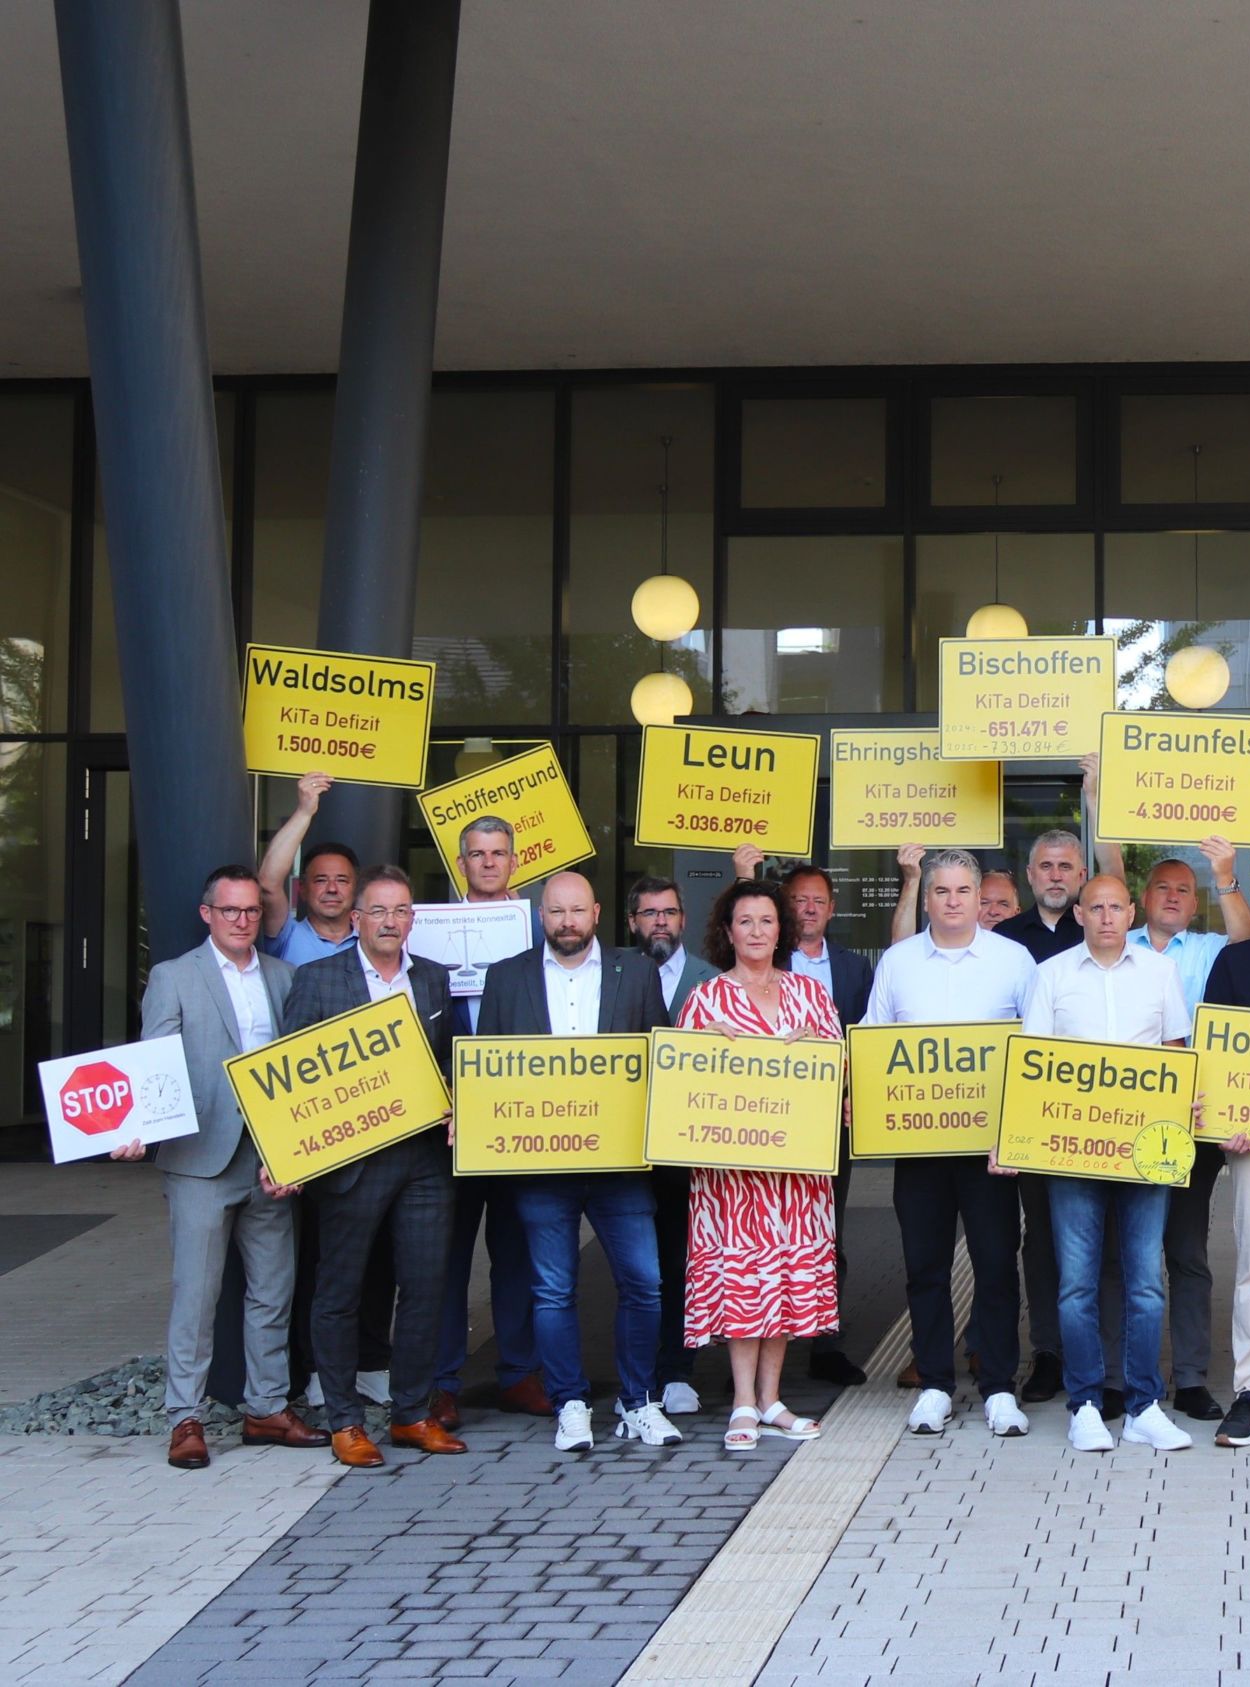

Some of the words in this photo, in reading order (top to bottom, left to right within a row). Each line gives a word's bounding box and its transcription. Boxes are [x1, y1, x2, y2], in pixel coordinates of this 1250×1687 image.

[959, 650, 1100, 676] Bischoffen
[252, 658, 425, 701] Waldsolms
[975, 694, 1012, 709] KiTa
[1019, 693, 1070, 708] Defizit
[280, 707, 319, 726] KiTa
[325, 711, 380, 732] Defizit
[980, 721, 1047, 737] -651.471
[1053, 720, 1068, 736] €
[277, 734, 377, 759] 1.500.050€
[683, 733, 775, 772] Leun
[836, 742, 939, 765] Ehringsha
[432, 760, 559, 826] Schöffengrund
[865, 784, 900, 799] KiTa
[907, 783, 957, 798] Defizit
[1136, 771, 1174, 789] KiTa
[1181, 773, 1235, 792] Defizit
[677, 784, 714, 801] KiTa
[720, 787, 771, 805] Defizit
[513, 810, 545, 833] efizit
[667, 814, 769, 835] -3.036.870€
[858, 812, 957, 828] -3.597.500€
[1128, 802, 1237, 823] -4.300.000€
[249, 1019, 403, 1101] Wetzlar
[460, 1048, 642, 1083] Hüttenberg
[656, 1043, 836, 1082] Greifenstein
[886, 1037, 996, 1075] Aßlar
[1021, 1049, 1178, 1094] Siegbach
[63, 1080, 129, 1117] STOP
[290, 1096, 333, 1123] KiTa
[335, 1069, 391, 1104] Defizit
[687, 1092, 727, 1110] KiTa
[734, 1095, 791, 1115] Defizit
[887, 1085, 925, 1101] KiTa
[932, 1083, 987, 1100] Defizit
[494, 1102, 535, 1118] KiTa
[542, 1100, 599, 1117] Defizit
[886, 1111, 988, 1131] 5.500.000€
[1042, 1101, 1082, 1121] KiTa
[1088, 1106, 1146, 1127] Defizit
[293, 1099, 407, 1157] -14.838.360€
[678, 1125, 787, 1148] -1.750.000€
[486, 1134, 600, 1153] -3.700.000€
[1041, 1134, 1134, 1159] -515.000€
